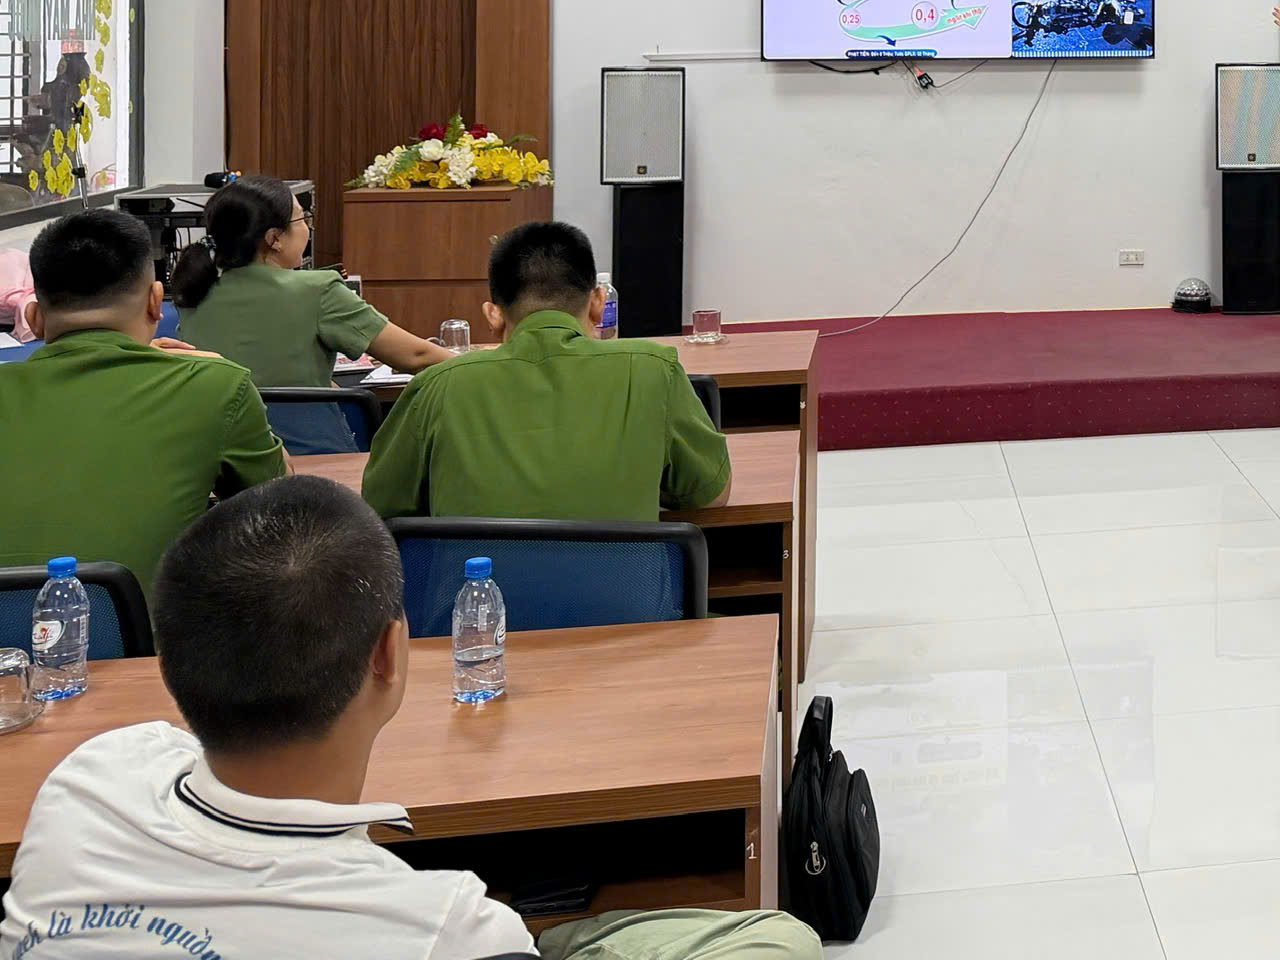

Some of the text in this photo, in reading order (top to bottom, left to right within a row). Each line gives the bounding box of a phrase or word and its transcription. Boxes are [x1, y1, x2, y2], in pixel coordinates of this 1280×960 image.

[842, 14, 860, 25] 0,25
[915, 8, 935, 22] 0,4
[746, 842, 757, 859] 1
[48, 909, 73, 938] là
[80, 903, 145, 930] khởi
